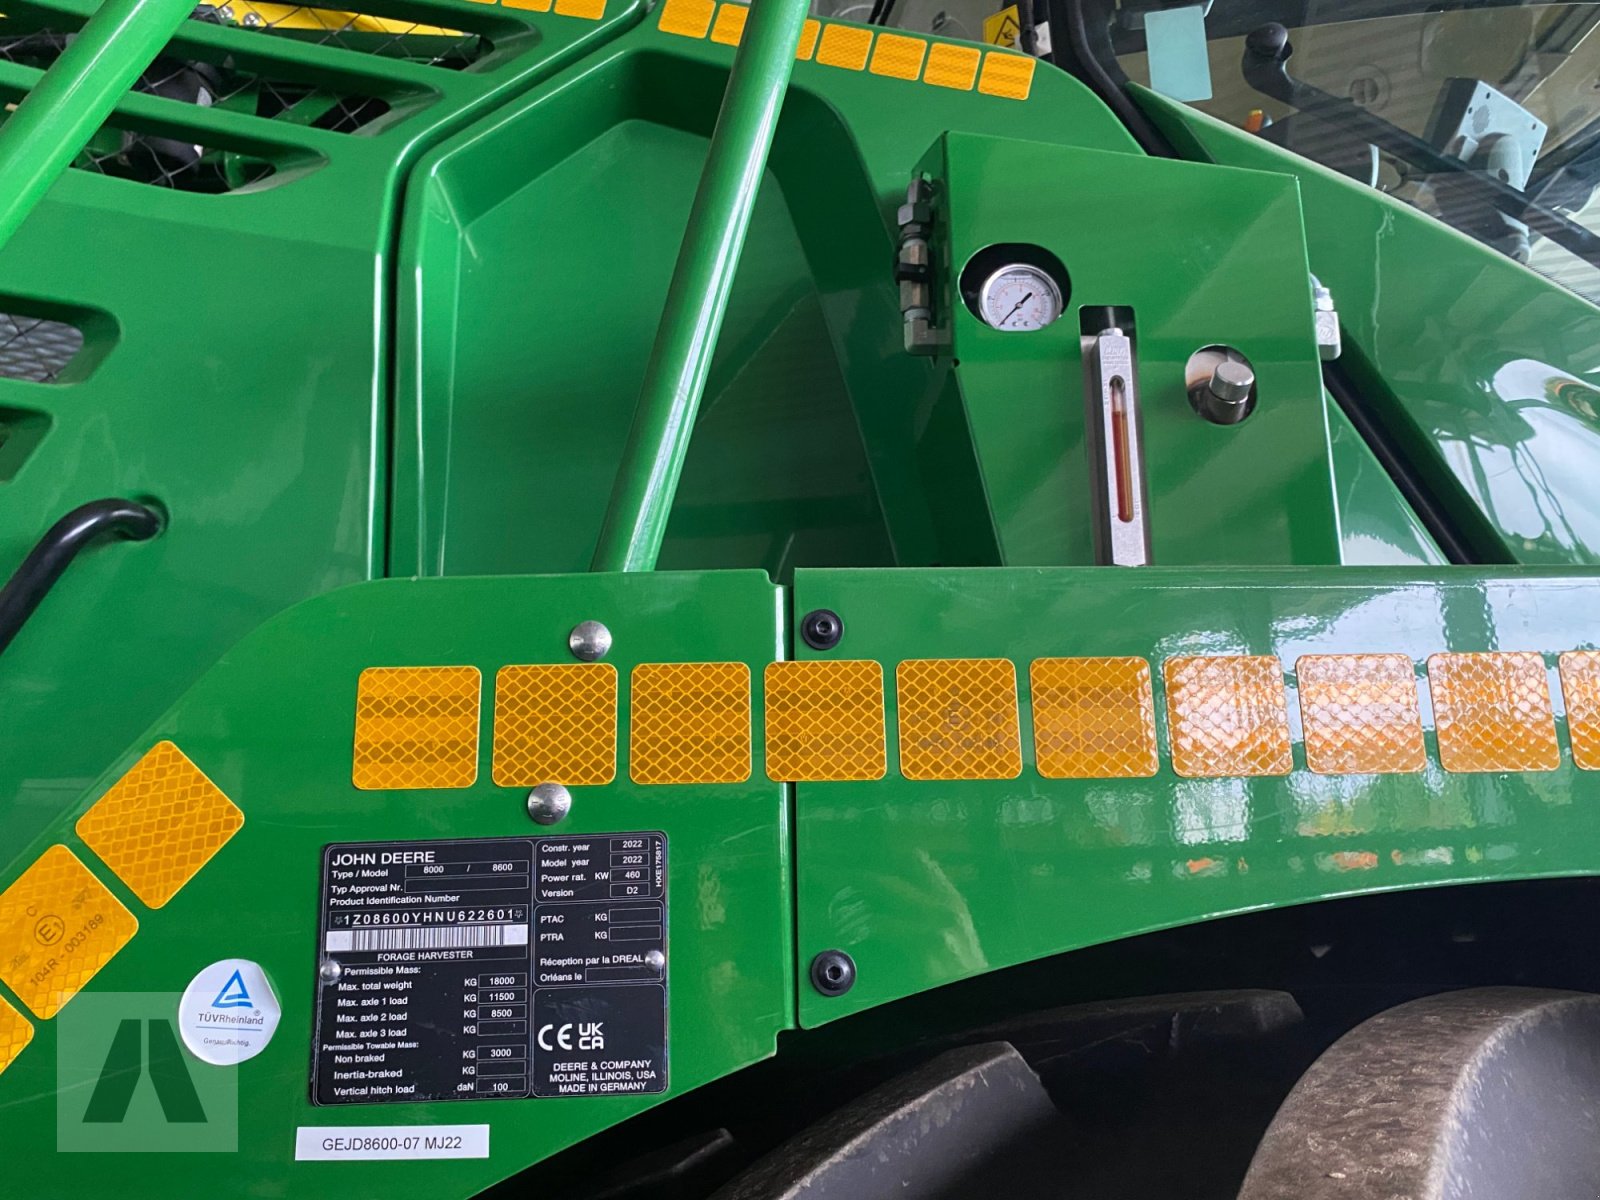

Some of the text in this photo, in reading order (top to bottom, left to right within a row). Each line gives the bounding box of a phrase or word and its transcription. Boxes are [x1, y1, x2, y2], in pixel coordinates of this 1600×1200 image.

[541, 843, 590, 853] Constr. year
[622, 840, 642, 848] 2022
[332, 851, 435, 866] JOHN DEERE
[571, 859, 589, 868] year
[622, 856, 642, 864] 2022
[423, 865, 444, 874] 8000
[492, 863, 513, 871] 8600
[331, 870, 353, 879] Type
[361, 869, 388, 877] Model
[541, 872, 609, 882] Power rat. KW
[625, 871, 640, 879] 460
[330, 884, 403, 895] Typ Approval Nr.
[627, 886, 638, 894] D2
[330, 895, 460, 906] Product Identification Number
[540, 915, 564, 923] PTAC
[540, 931, 608, 941] PTRA KG
[377, 951, 473, 961] FORAGE HARVESTER
[540, 958, 583, 967] Réception
[586, 958, 599, 968] par
[612, 955, 644, 963] DREAL
[344, 966, 421, 976] Permissible Mass:
[489, 977, 515, 985] 18000
[540, 972, 582, 982] Orléans le
[338, 981, 412, 991] Max. total weight
[464, 978, 477, 987] KG
[464, 994, 477, 1002] KG
[489, 993, 514, 1001] 11500
[337, 999, 358, 1007] Max.
[336, 1014, 357, 1022] Max.
[360, 1013, 378, 1021] axle
[389, 1012, 407, 1020] load
[463, 1010, 477, 1018] KG
[491, 1009, 513, 1017] 8500
[336, 1030, 357, 1038] Max.
[360, 1029, 378, 1038] axle
[388, 1028, 407, 1036] load
[463, 1026, 476, 1034] KG
[538, 1023, 603, 1051] CE UK
[578, 1037, 604, 1050] CA
[463, 1050, 476, 1059] KG
[490, 1049, 512, 1057] 3000
[335, 1054, 385, 1063] Non braked
[462, 1066, 475, 1075] KG
[553, 1060, 652, 1071] DEERE & COMPANY
[334, 1069, 403, 1079] Inertia-braked
[549, 1071, 656, 1083] MOLINE, ILLINOIS, USA
[334, 1085, 415, 1095] Vertical hitch load
[457, 1083, 474, 1091] daN
[493, 1083, 508, 1091] 100
[559, 1084, 586, 1092] MADE
[600, 1082, 646, 1091] GERMANY
[322, 1136, 462, 1151] GEJD8600-07 MJ22
